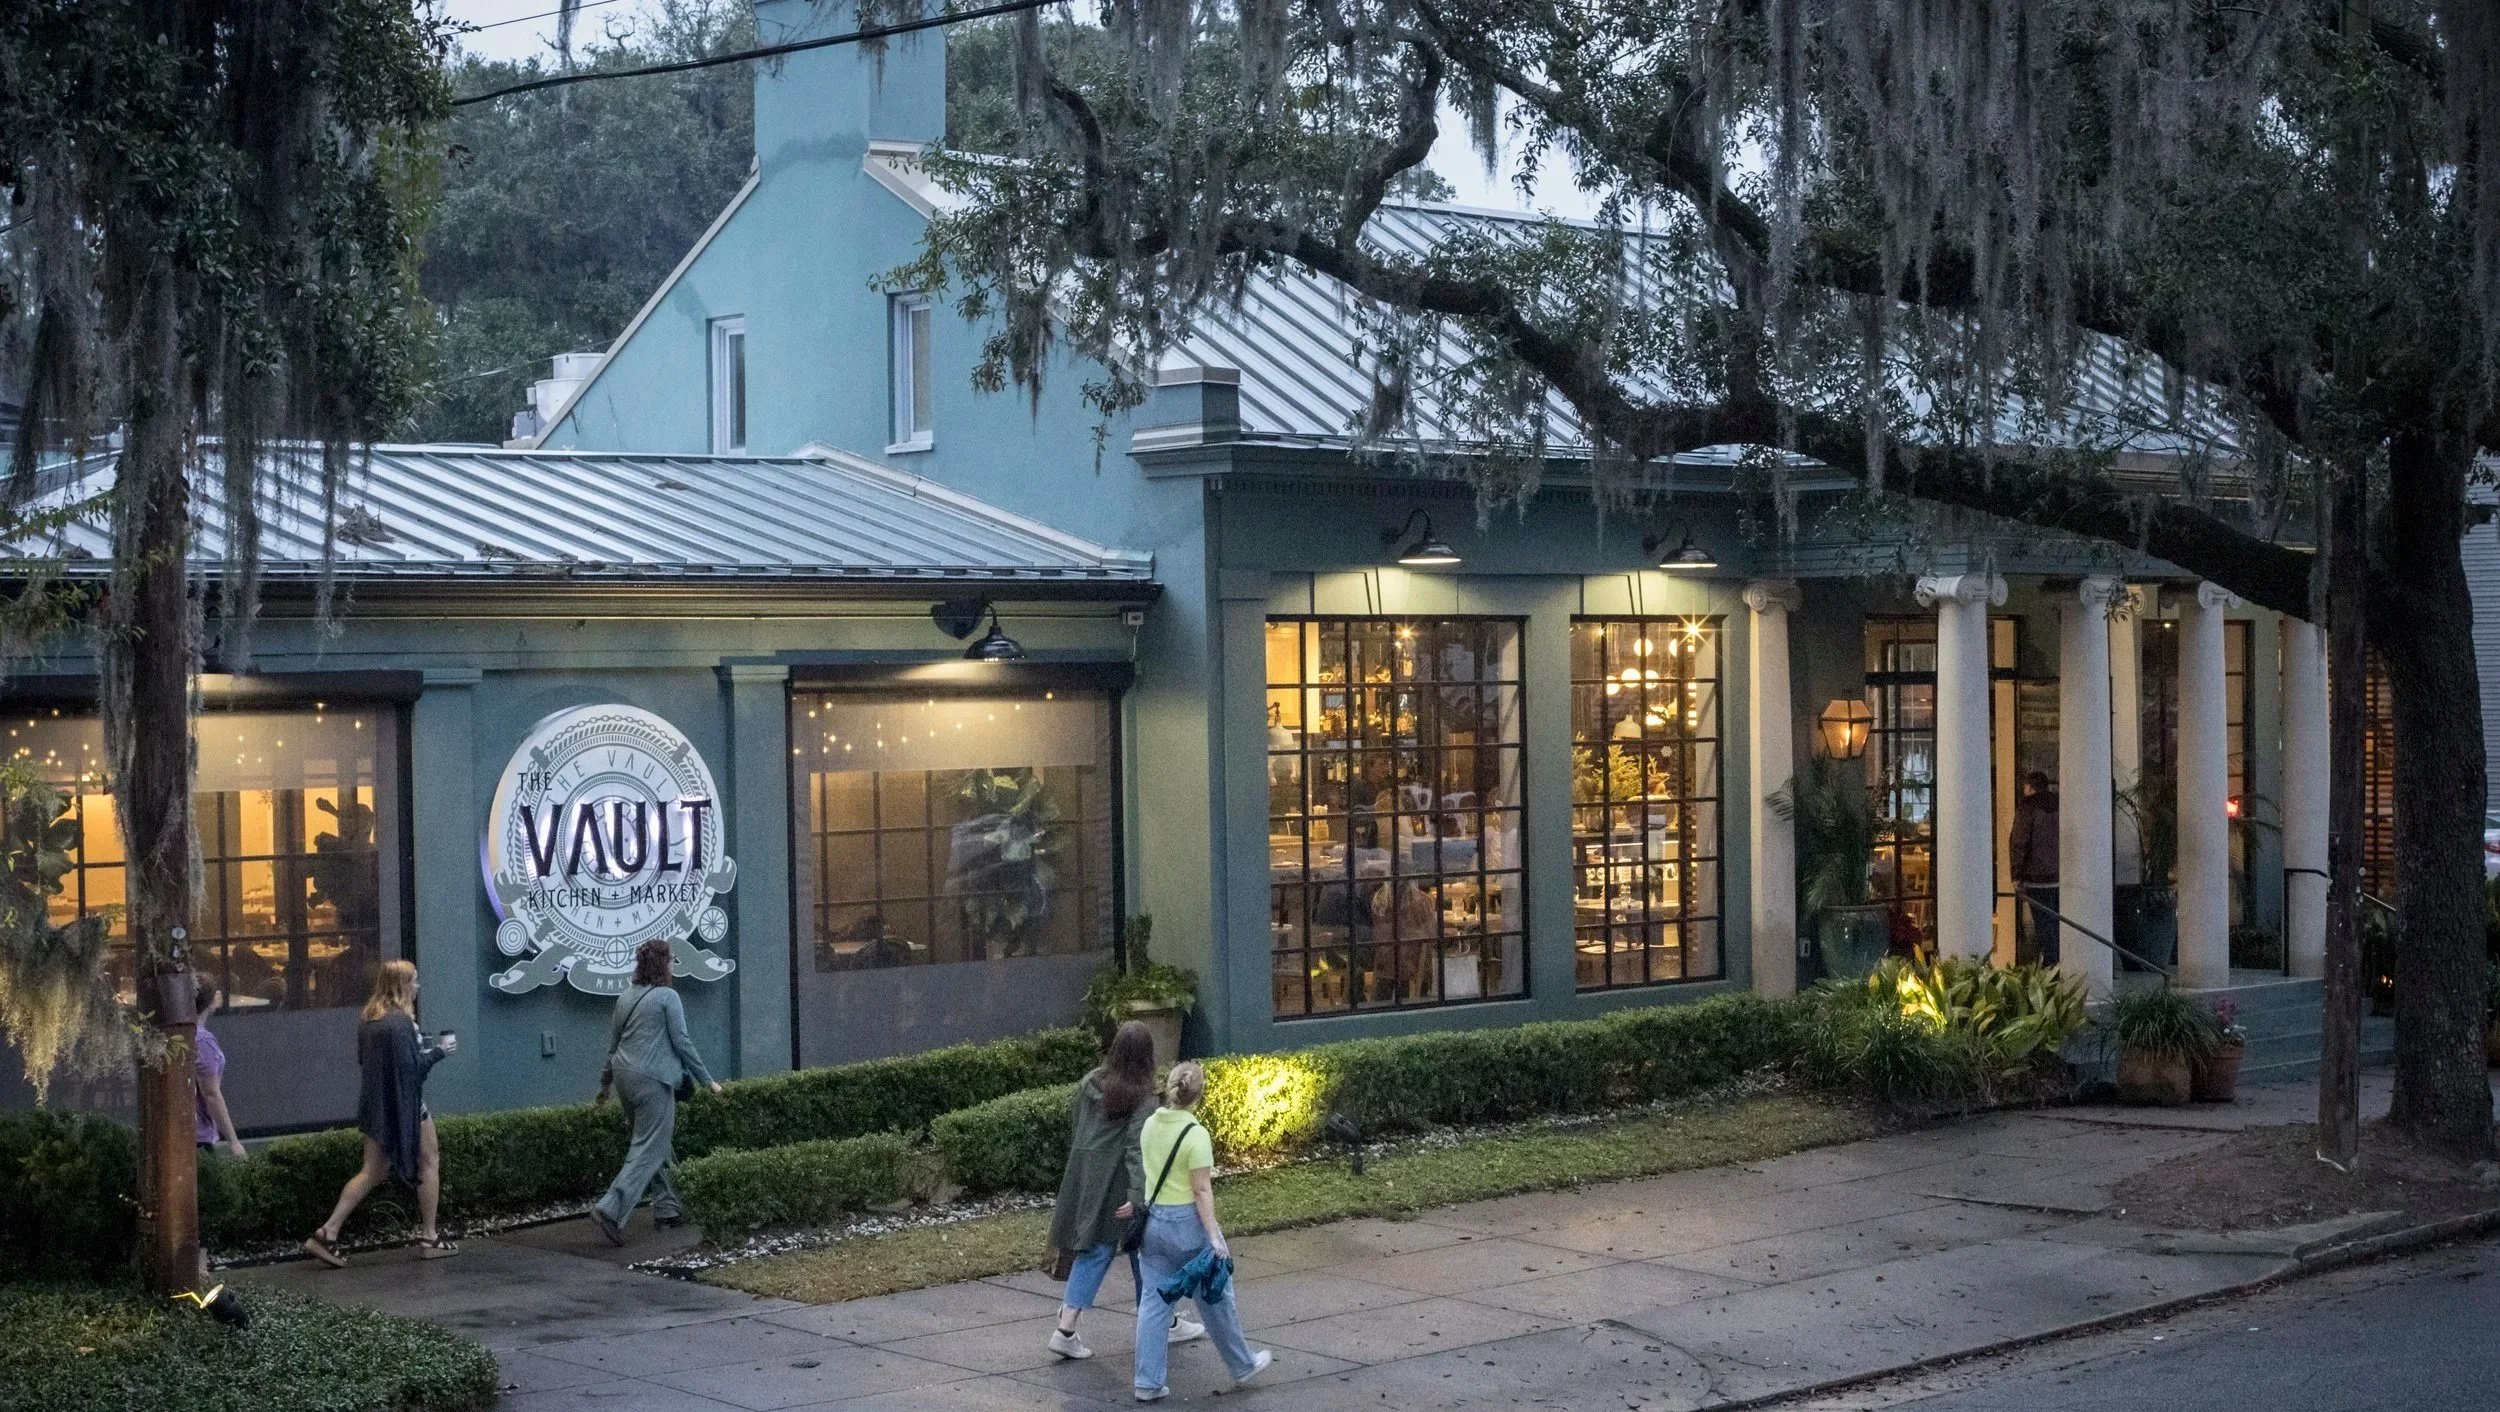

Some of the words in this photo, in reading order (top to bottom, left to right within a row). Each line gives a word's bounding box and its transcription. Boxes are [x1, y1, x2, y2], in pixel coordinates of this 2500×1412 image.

[517, 771, 552, 792] THE
[545, 760, 585, 804] THE
[519, 798, 712, 878] VAULT
[528, 887, 601, 910] KITCHEN
[629, 883, 698, 904] MARKET
